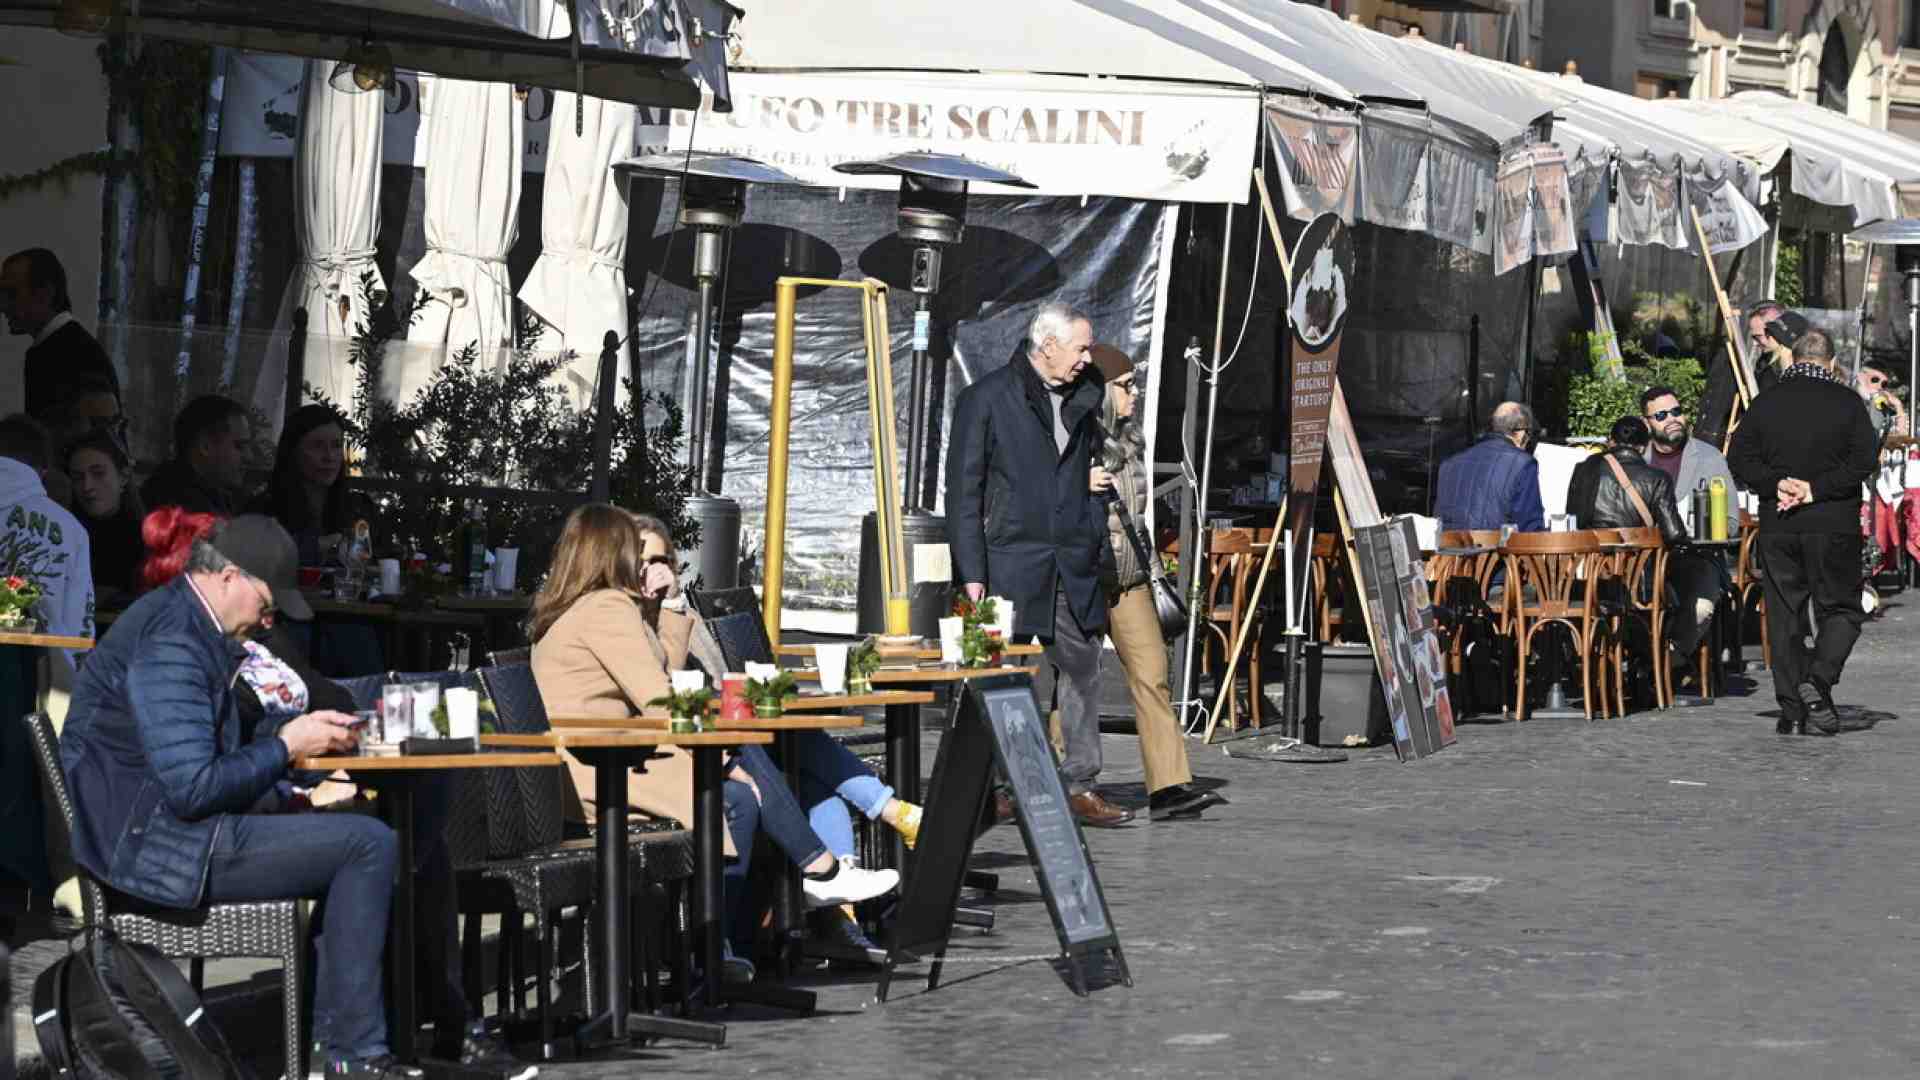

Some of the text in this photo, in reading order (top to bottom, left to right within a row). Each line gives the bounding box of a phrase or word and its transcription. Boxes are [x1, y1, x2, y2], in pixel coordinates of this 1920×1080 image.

[835, 100, 934, 138] TRE
[946, 104, 1146, 146] SCALINI
[1296, 360, 1310, 375] THE
